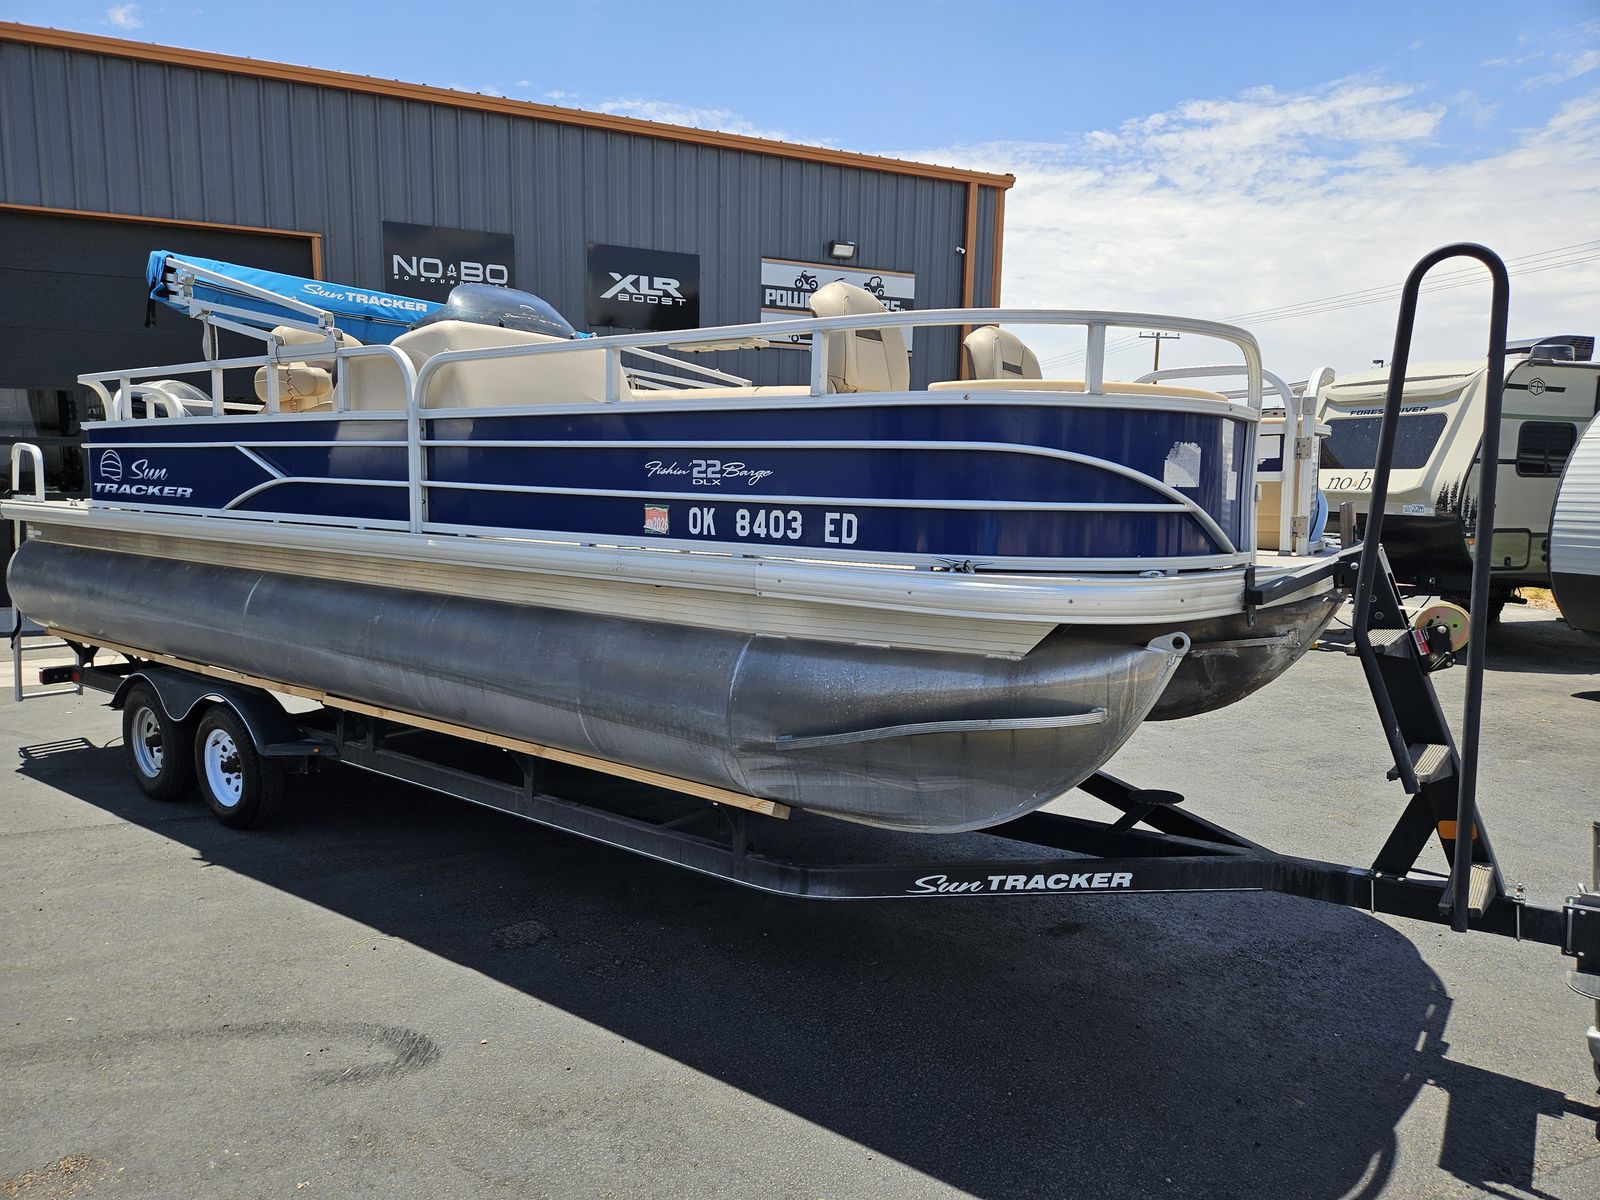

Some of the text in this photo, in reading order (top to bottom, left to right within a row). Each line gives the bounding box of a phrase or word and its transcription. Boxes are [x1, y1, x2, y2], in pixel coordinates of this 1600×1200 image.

[393, 255, 508, 284] NO BO
[600, 272, 683, 298] XLR
[300, 284, 428, 312] Sun TRACKER
[618, 293, 686, 306] BOOST
[1350, 408, 1385, 416] FORES
[128, 459, 168, 480] Sun
[692, 460, 721, 478] 22
[722, 462, 773, 486] Barge
[94, 482, 193, 498] TRACKER
[688, 507, 858, 544] OK 8403 ED
[905, 872, 1133, 894] Sun TRACKER
